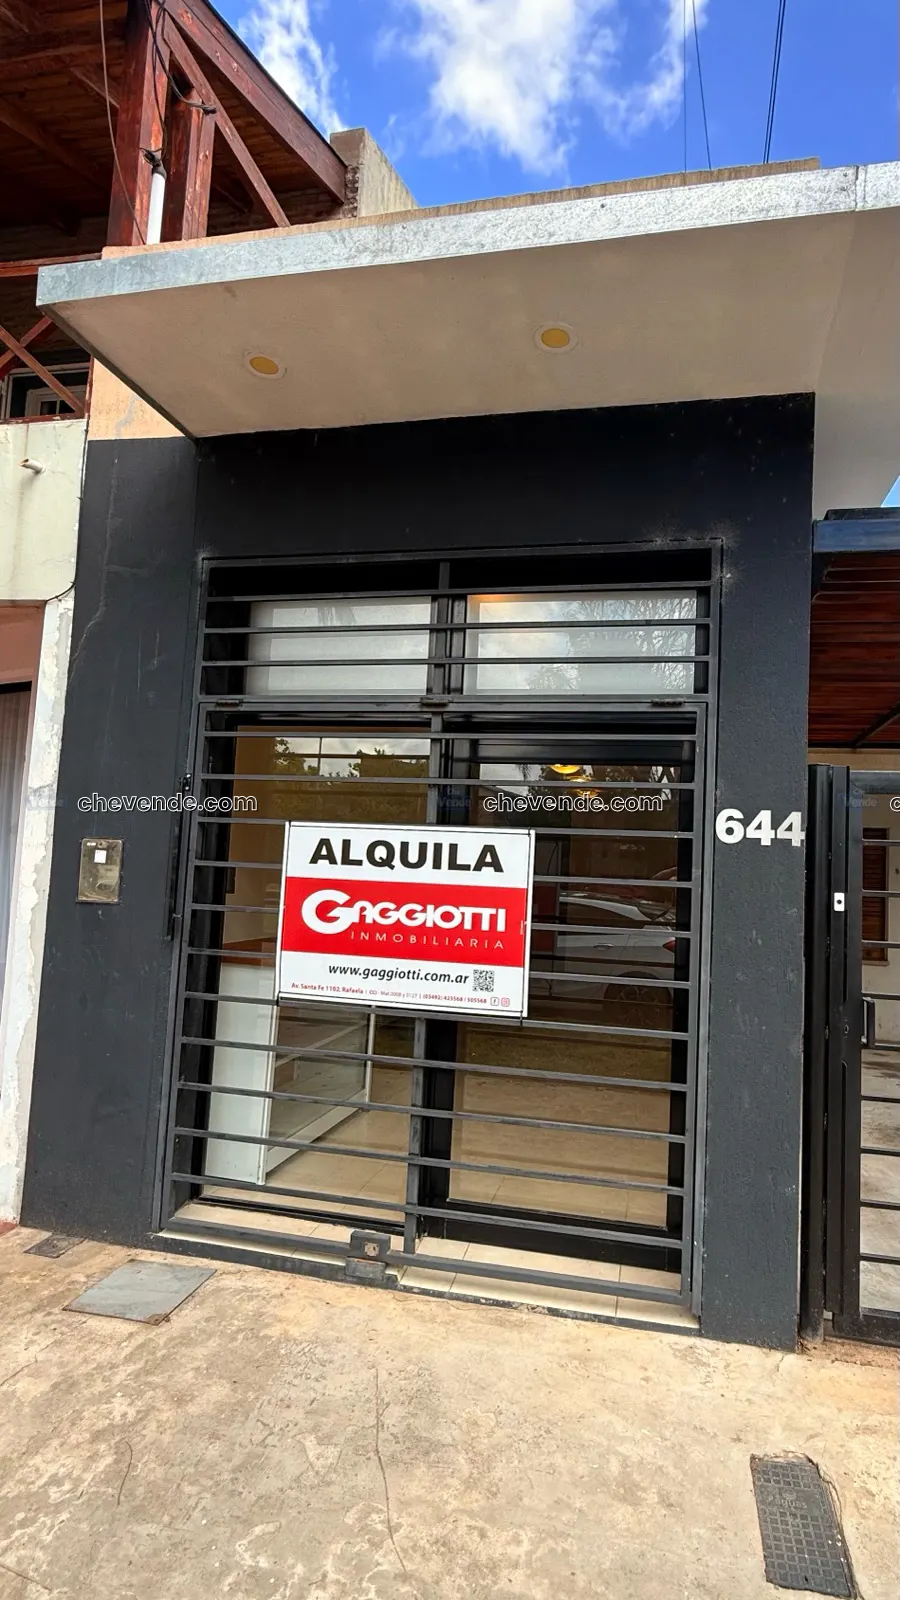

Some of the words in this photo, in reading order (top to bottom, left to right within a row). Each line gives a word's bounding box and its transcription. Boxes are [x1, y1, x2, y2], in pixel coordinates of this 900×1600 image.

[715, 808, 806, 847] 644
[309, 838, 504, 873] ALQUILA
[301, 889, 506, 934] GAGGIOTTI
[351, 930, 504, 949] INMOBILIARIA
[300, 983, 317, 991] Santa
[328, 965, 470, 984] www.gaggiotti.com.ar
